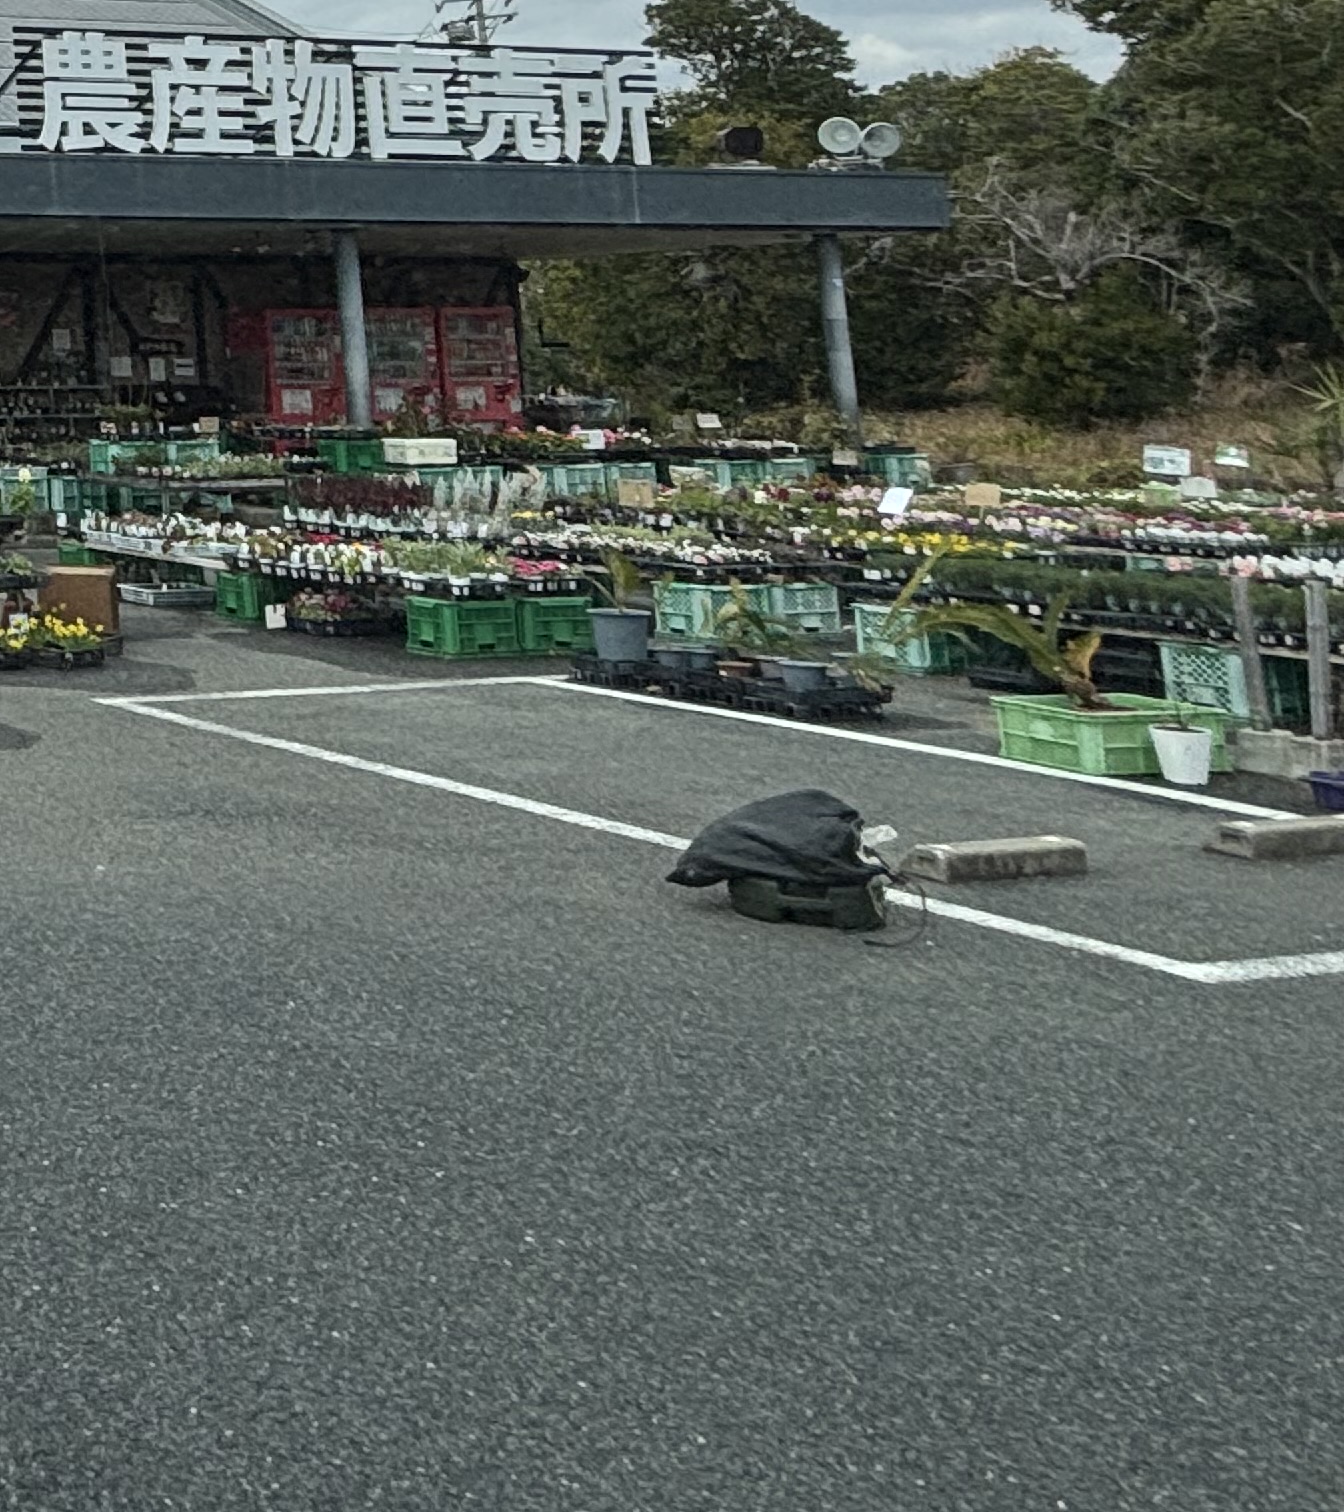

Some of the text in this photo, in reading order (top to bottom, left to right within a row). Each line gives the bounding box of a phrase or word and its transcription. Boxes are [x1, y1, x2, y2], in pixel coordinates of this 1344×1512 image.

[36, 29, 657, 166] 農産物直売所
